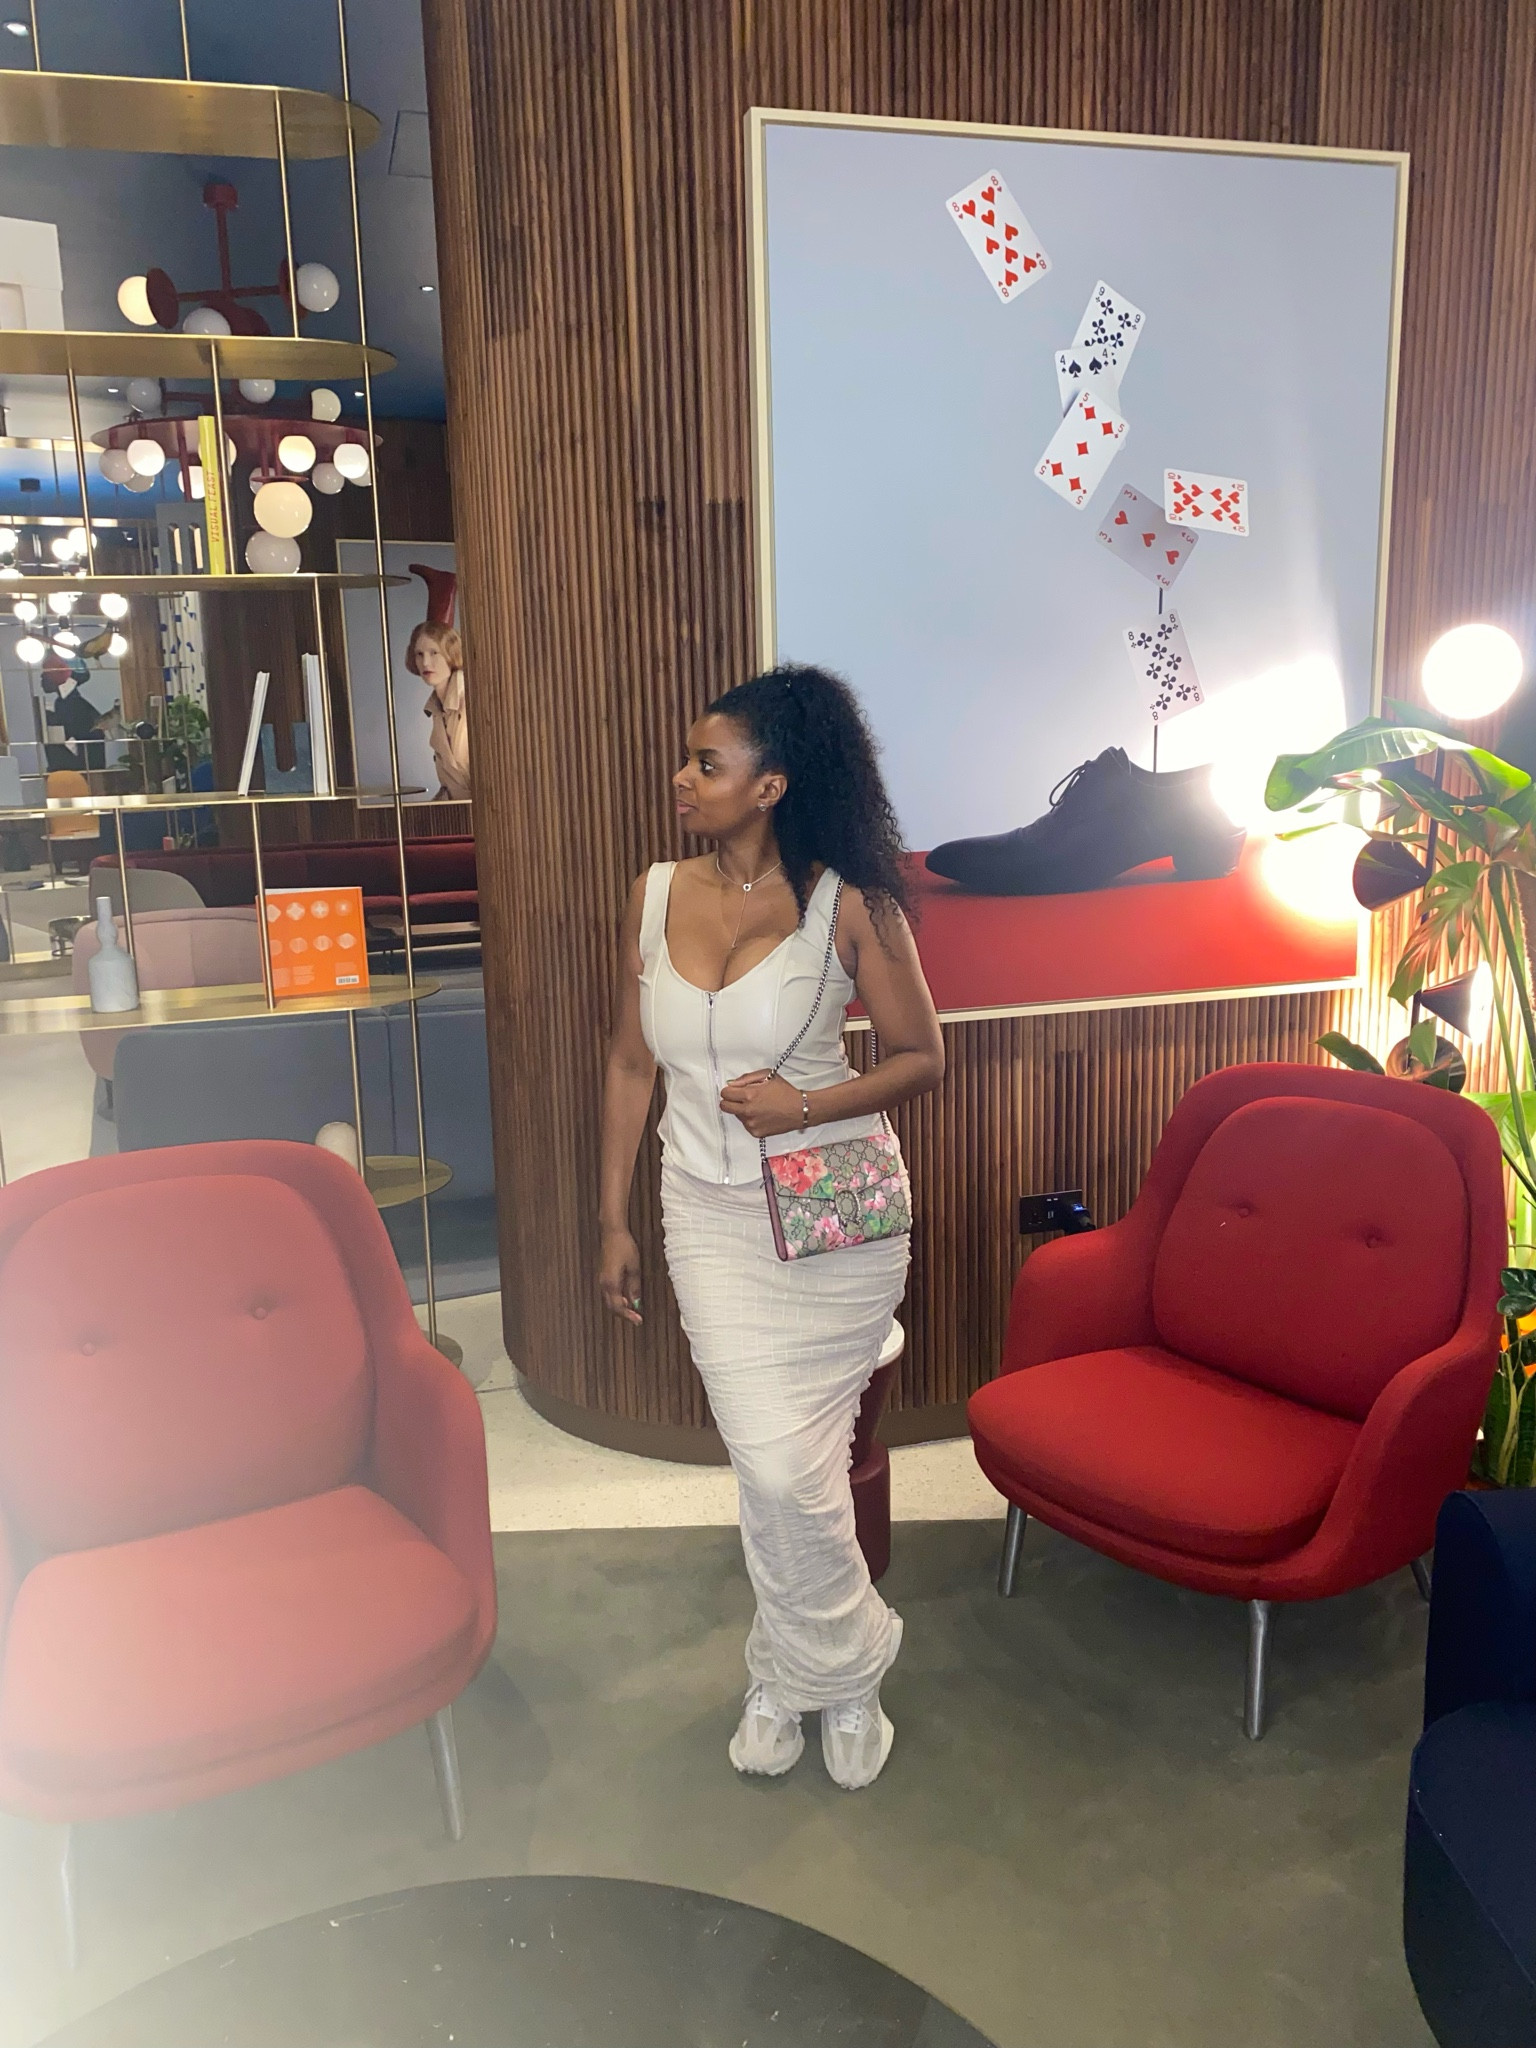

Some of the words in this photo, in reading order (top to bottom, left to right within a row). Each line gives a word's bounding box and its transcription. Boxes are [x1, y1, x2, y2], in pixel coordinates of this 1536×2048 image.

[991, 176, 998, 185] 8
[952, 202, 959, 212] 8
[1039, 260, 1046, 269] 8
[1001, 287, 1009, 297] 8
[1099, 286, 1105, 296] 9
[1135, 314, 1141, 323] 9
[1102, 348, 1108, 358] 4
[1060, 355, 1066, 365] 4
[1083, 392, 1090, 402] 5
[1118, 424, 1124, 432] 5
[1039, 465, 1047, 475] 5
[1123, 490, 1132, 498] 3
[1076, 495, 1083, 505] 5
[210, 505, 220, 543] VISUAL
[1098, 531, 1108, 540] 3
[1185, 536, 1195, 544] 3
[1161, 578, 1170, 586] 3
[1169, 614, 1176, 623] 8
[1128, 631, 1134, 640] 8
[1194, 692, 1200, 702] 8
[1152, 711, 1158, 721] 8
